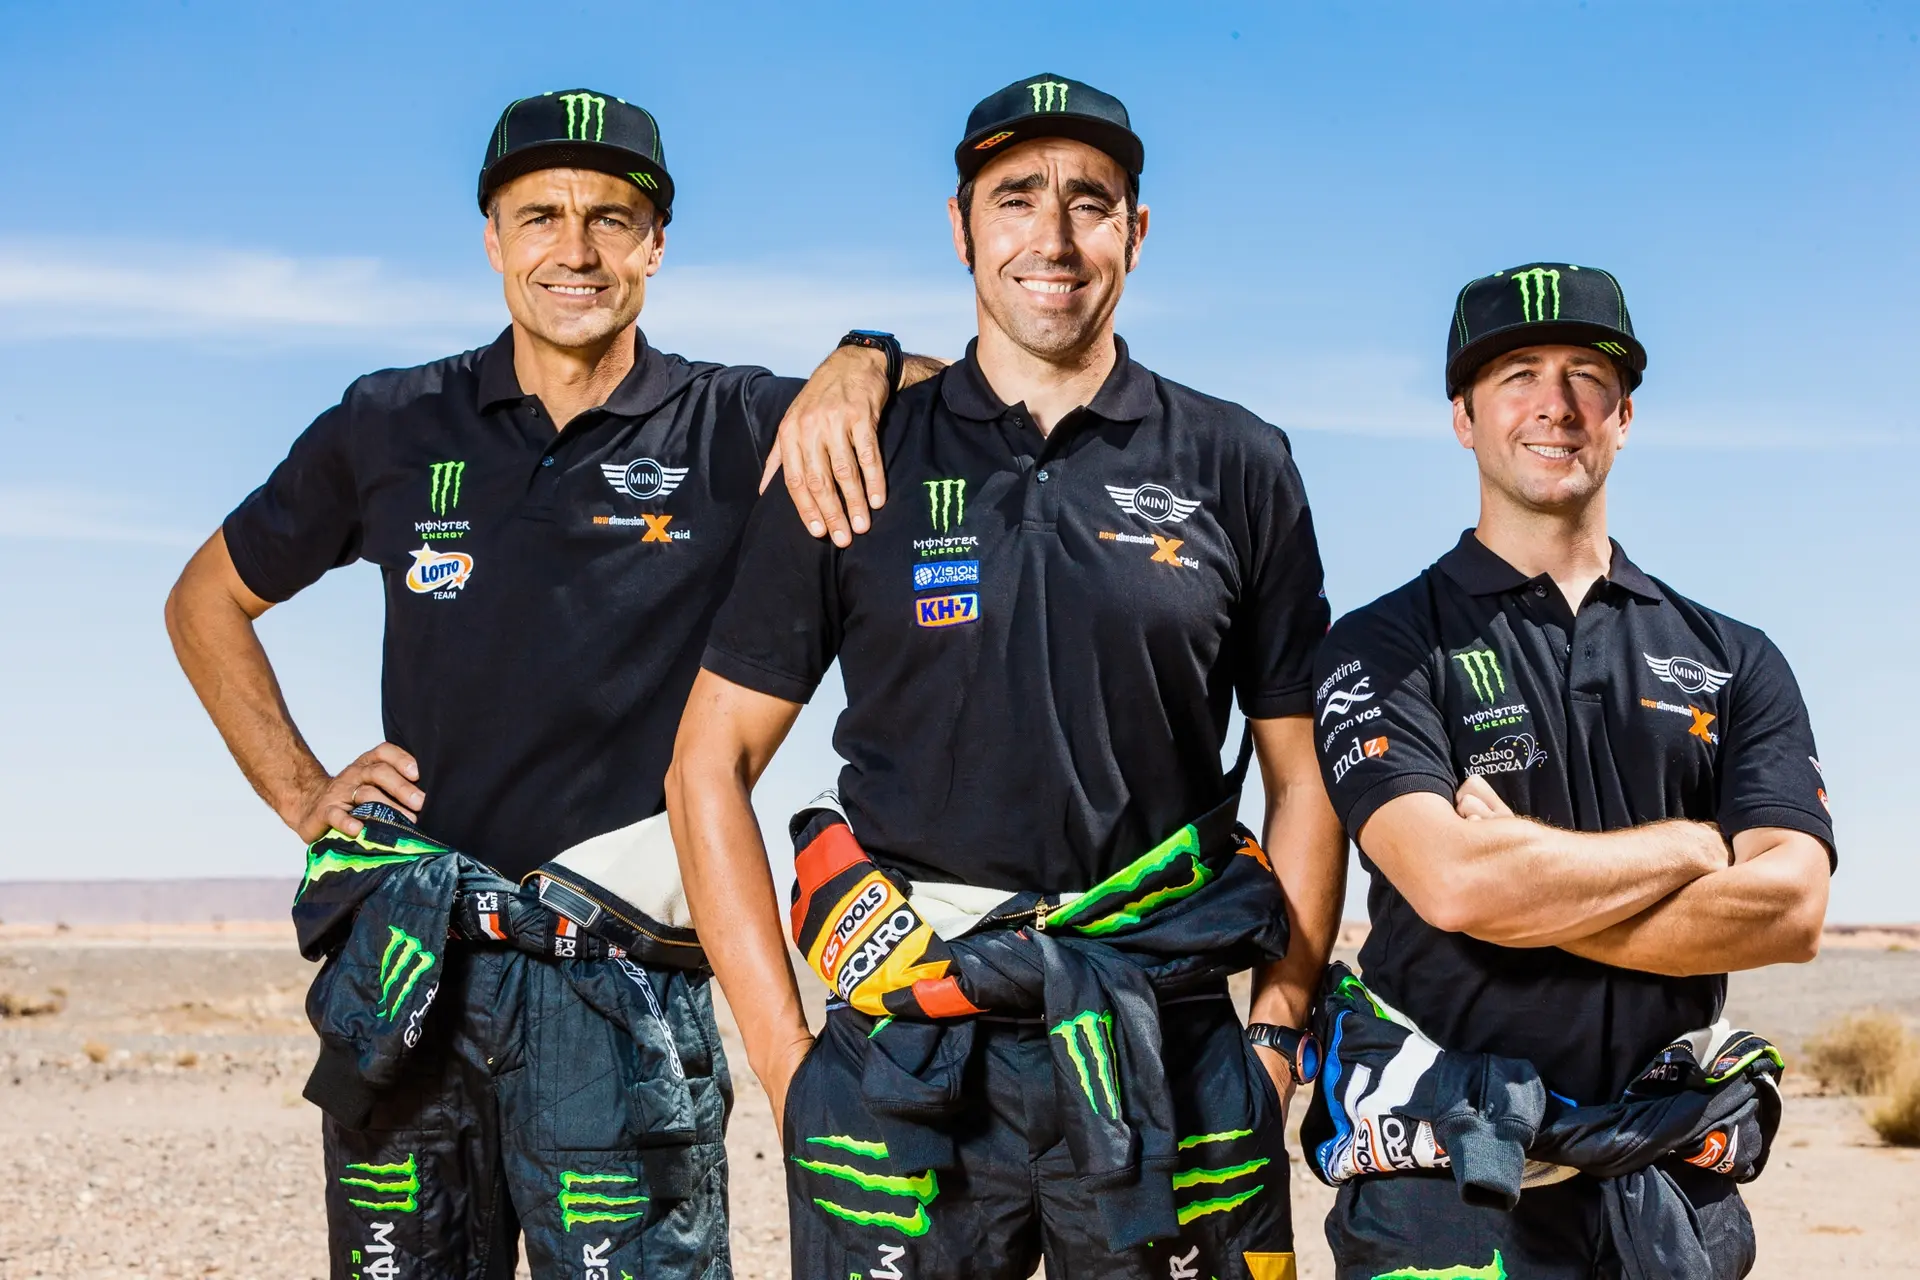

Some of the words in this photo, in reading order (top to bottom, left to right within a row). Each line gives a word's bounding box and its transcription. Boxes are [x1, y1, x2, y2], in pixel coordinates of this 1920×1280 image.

[631, 473, 658, 485] MINI
[1139, 495, 1169, 511] MINI
[414, 520, 471, 533] MONSTER
[421, 532, 464, 540] ENERGY
[913, 536, 979, 550] MONSTER
[921, 546, 972, 557] ENERGY
[421, 560, 460, 583] LOTTO
[931, 565, 977, 577] VISION
[933, 573, 978, 584] ADVISORS
[433, 591, 457, 600] TEAM
[920, 596, 974, 623] KH-7
[1673, 665, 1702, 681] MINI
[1316, 659, 1362, 706] Argentina
[1463, 704, 1529, 725] MONSTER
[1334, 718, 1355, 735] con
[1473, 715, 1523, 732] ENERGY
[1332, 736, 1382, 784] mdz
[1469, 748, 1515, 766] CASINO
[1463, 758, 1524, 779] MENDOZA
[835, 884, 884, 940] TOOLS
